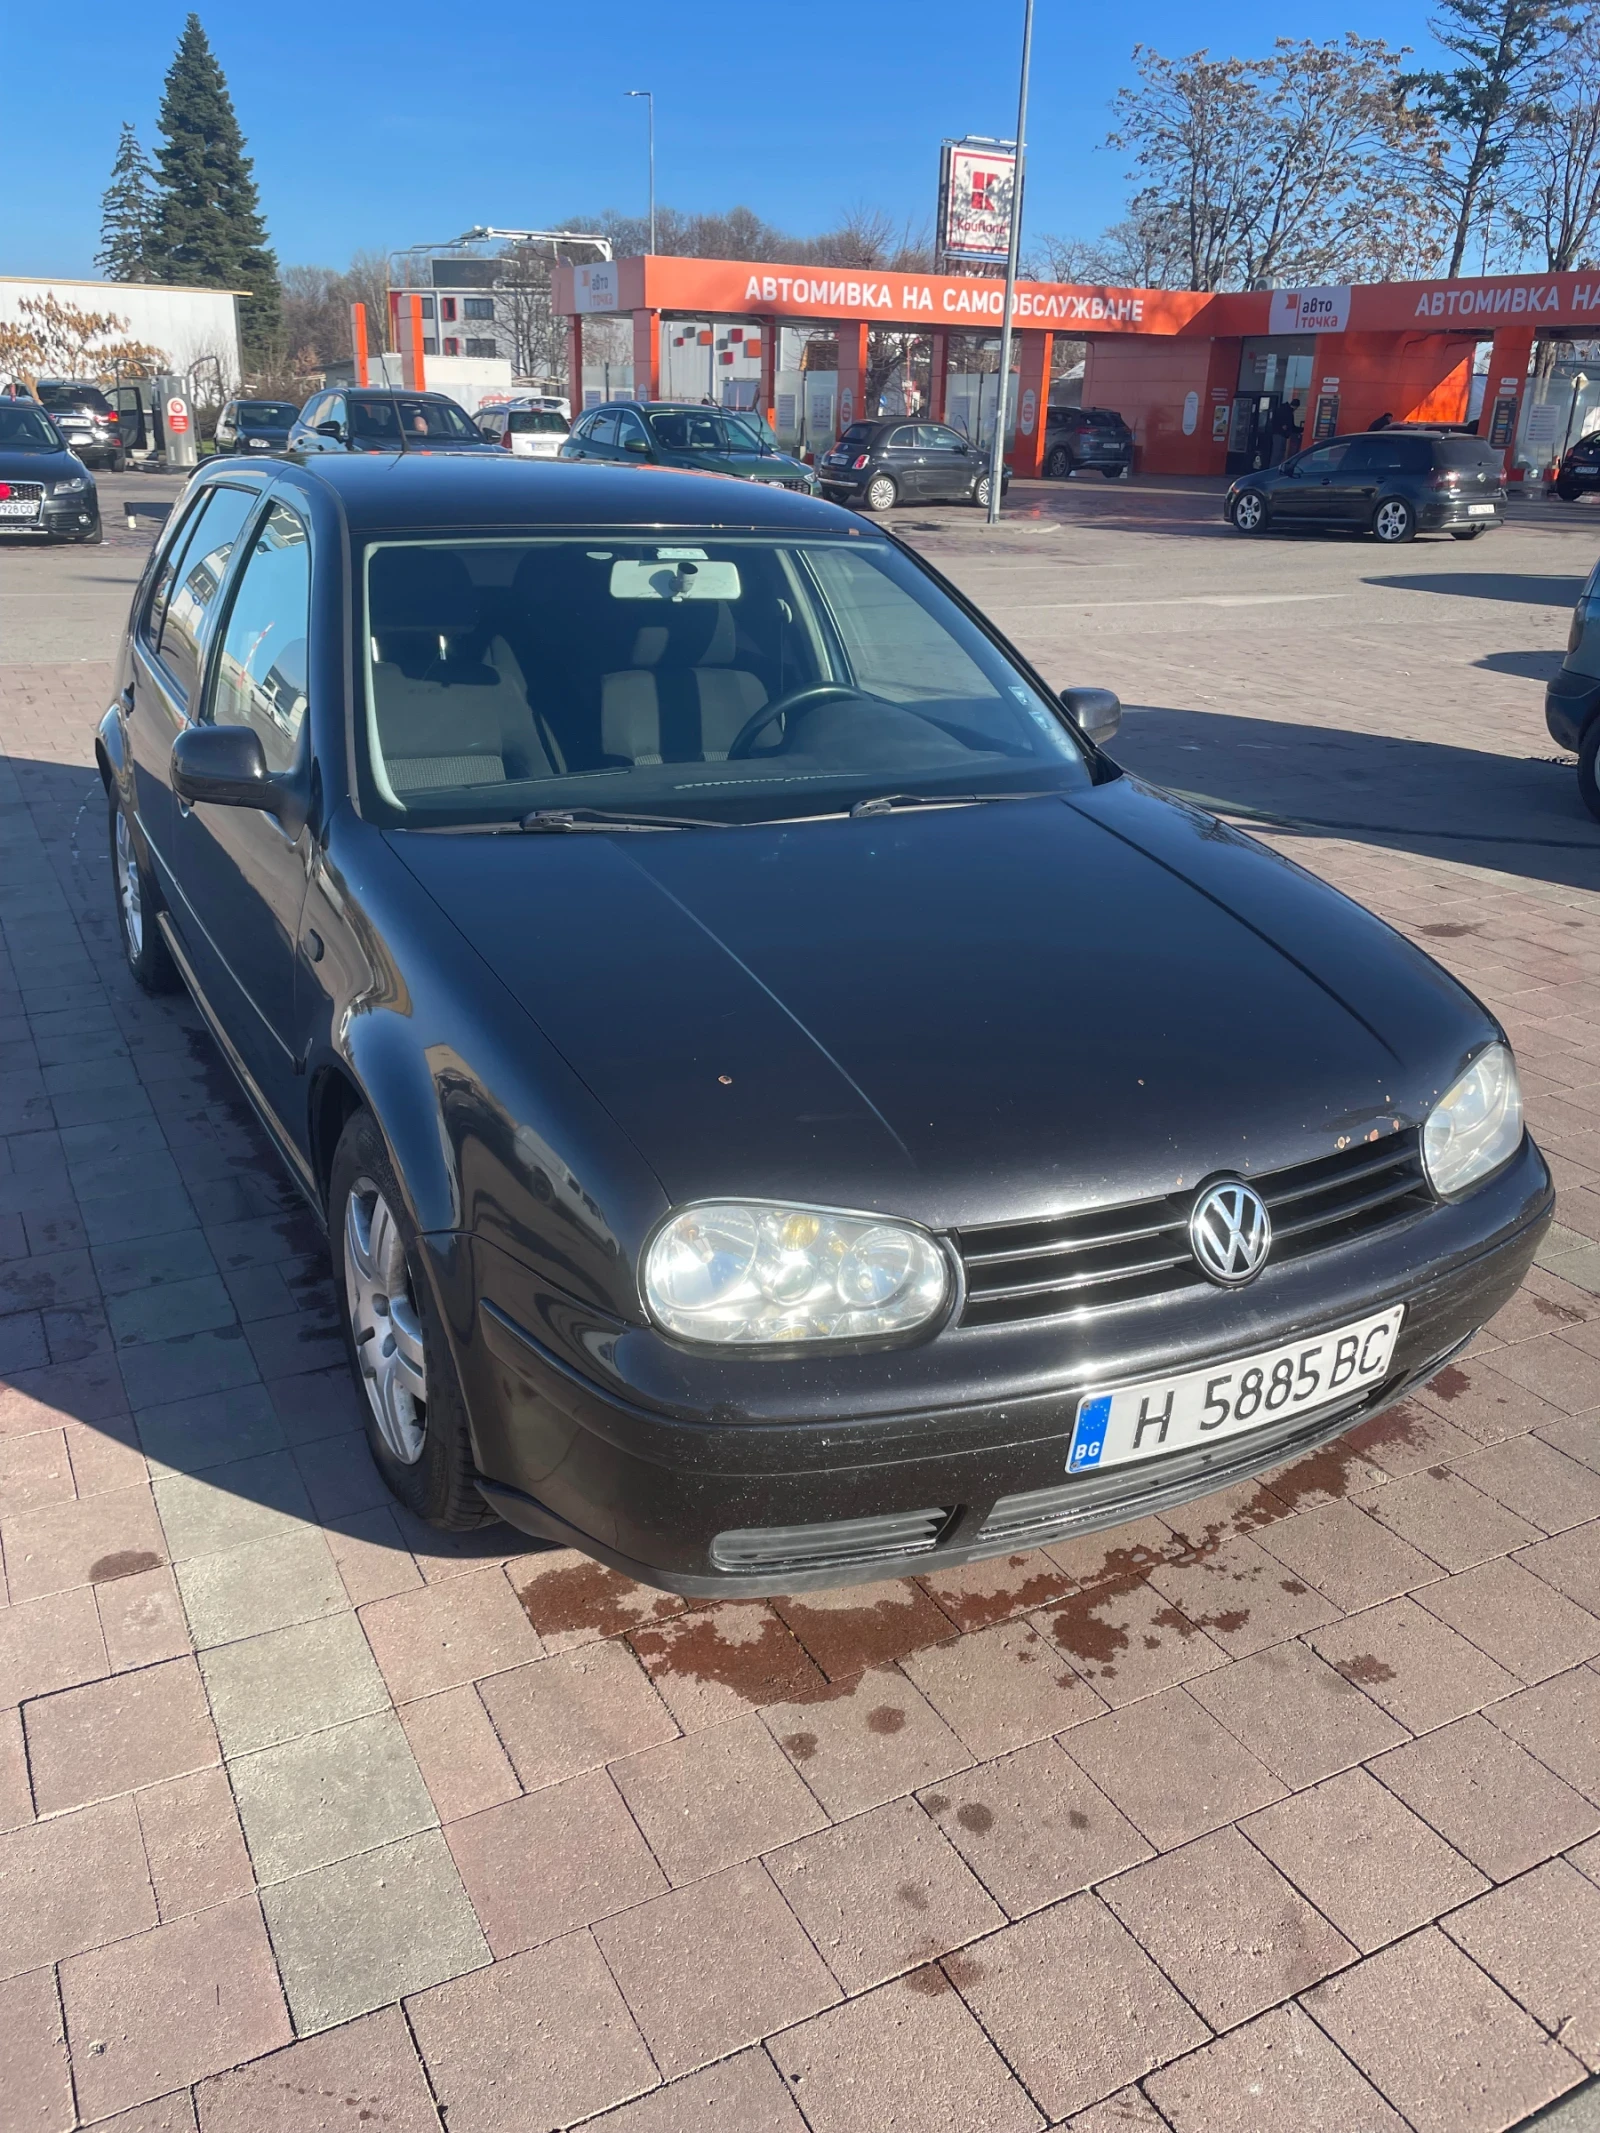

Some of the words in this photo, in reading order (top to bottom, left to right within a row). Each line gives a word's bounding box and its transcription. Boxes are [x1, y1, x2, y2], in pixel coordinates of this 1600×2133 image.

[745, 275, 893, 308] АВТОМИВКА
[902, 286, 934, 310] НА
[1415, 286, 1560, 317] АВТОМИВКА
[1302, 297, 1333, 313] авто
[1302, 315, 1338, 329] точка
[0, 505, 19, 514] 928
[1132, 1390, 1175, 1449] H
[1199, 1349, 1322, 1431] 5885
[1327, 1324, 1390, 1390] BC
[1074, 1441, 1100, 1461] BG
